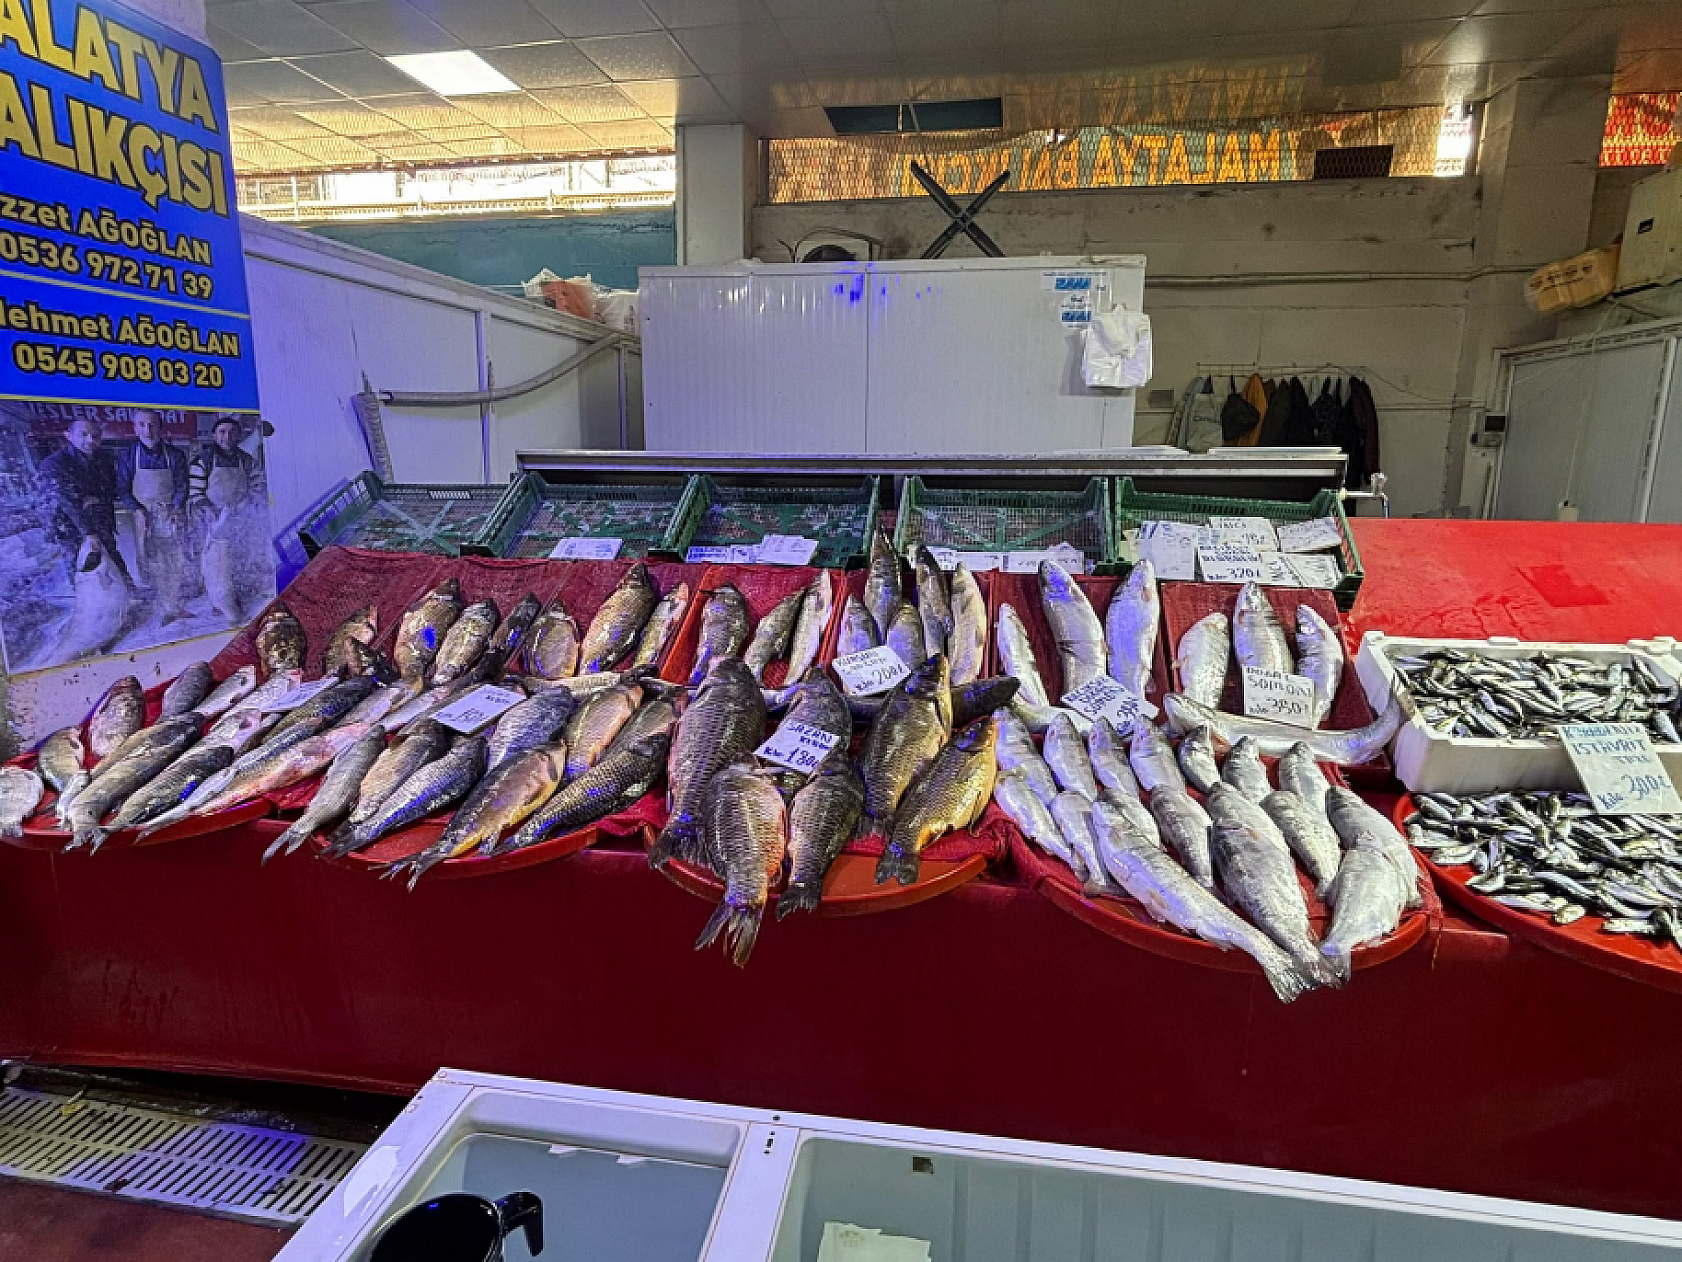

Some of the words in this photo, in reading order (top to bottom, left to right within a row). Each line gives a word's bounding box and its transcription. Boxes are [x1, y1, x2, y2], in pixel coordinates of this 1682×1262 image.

[78, 207, 213, 267] AĞOĞLAN
[0, 229, 80, 273] 0536
[86, 249, 143, 288] 972
[143, 261, 178, 294] 71
[182, 270, 213, 300] 39
[118, 313, 241, 359] AĞOĞLAN
[13, 341, 96, 377] 0545
[101, 351, 154, 383] 908
[157, 358, 191, 387] 03
[194, 362, 224, 390] 20
